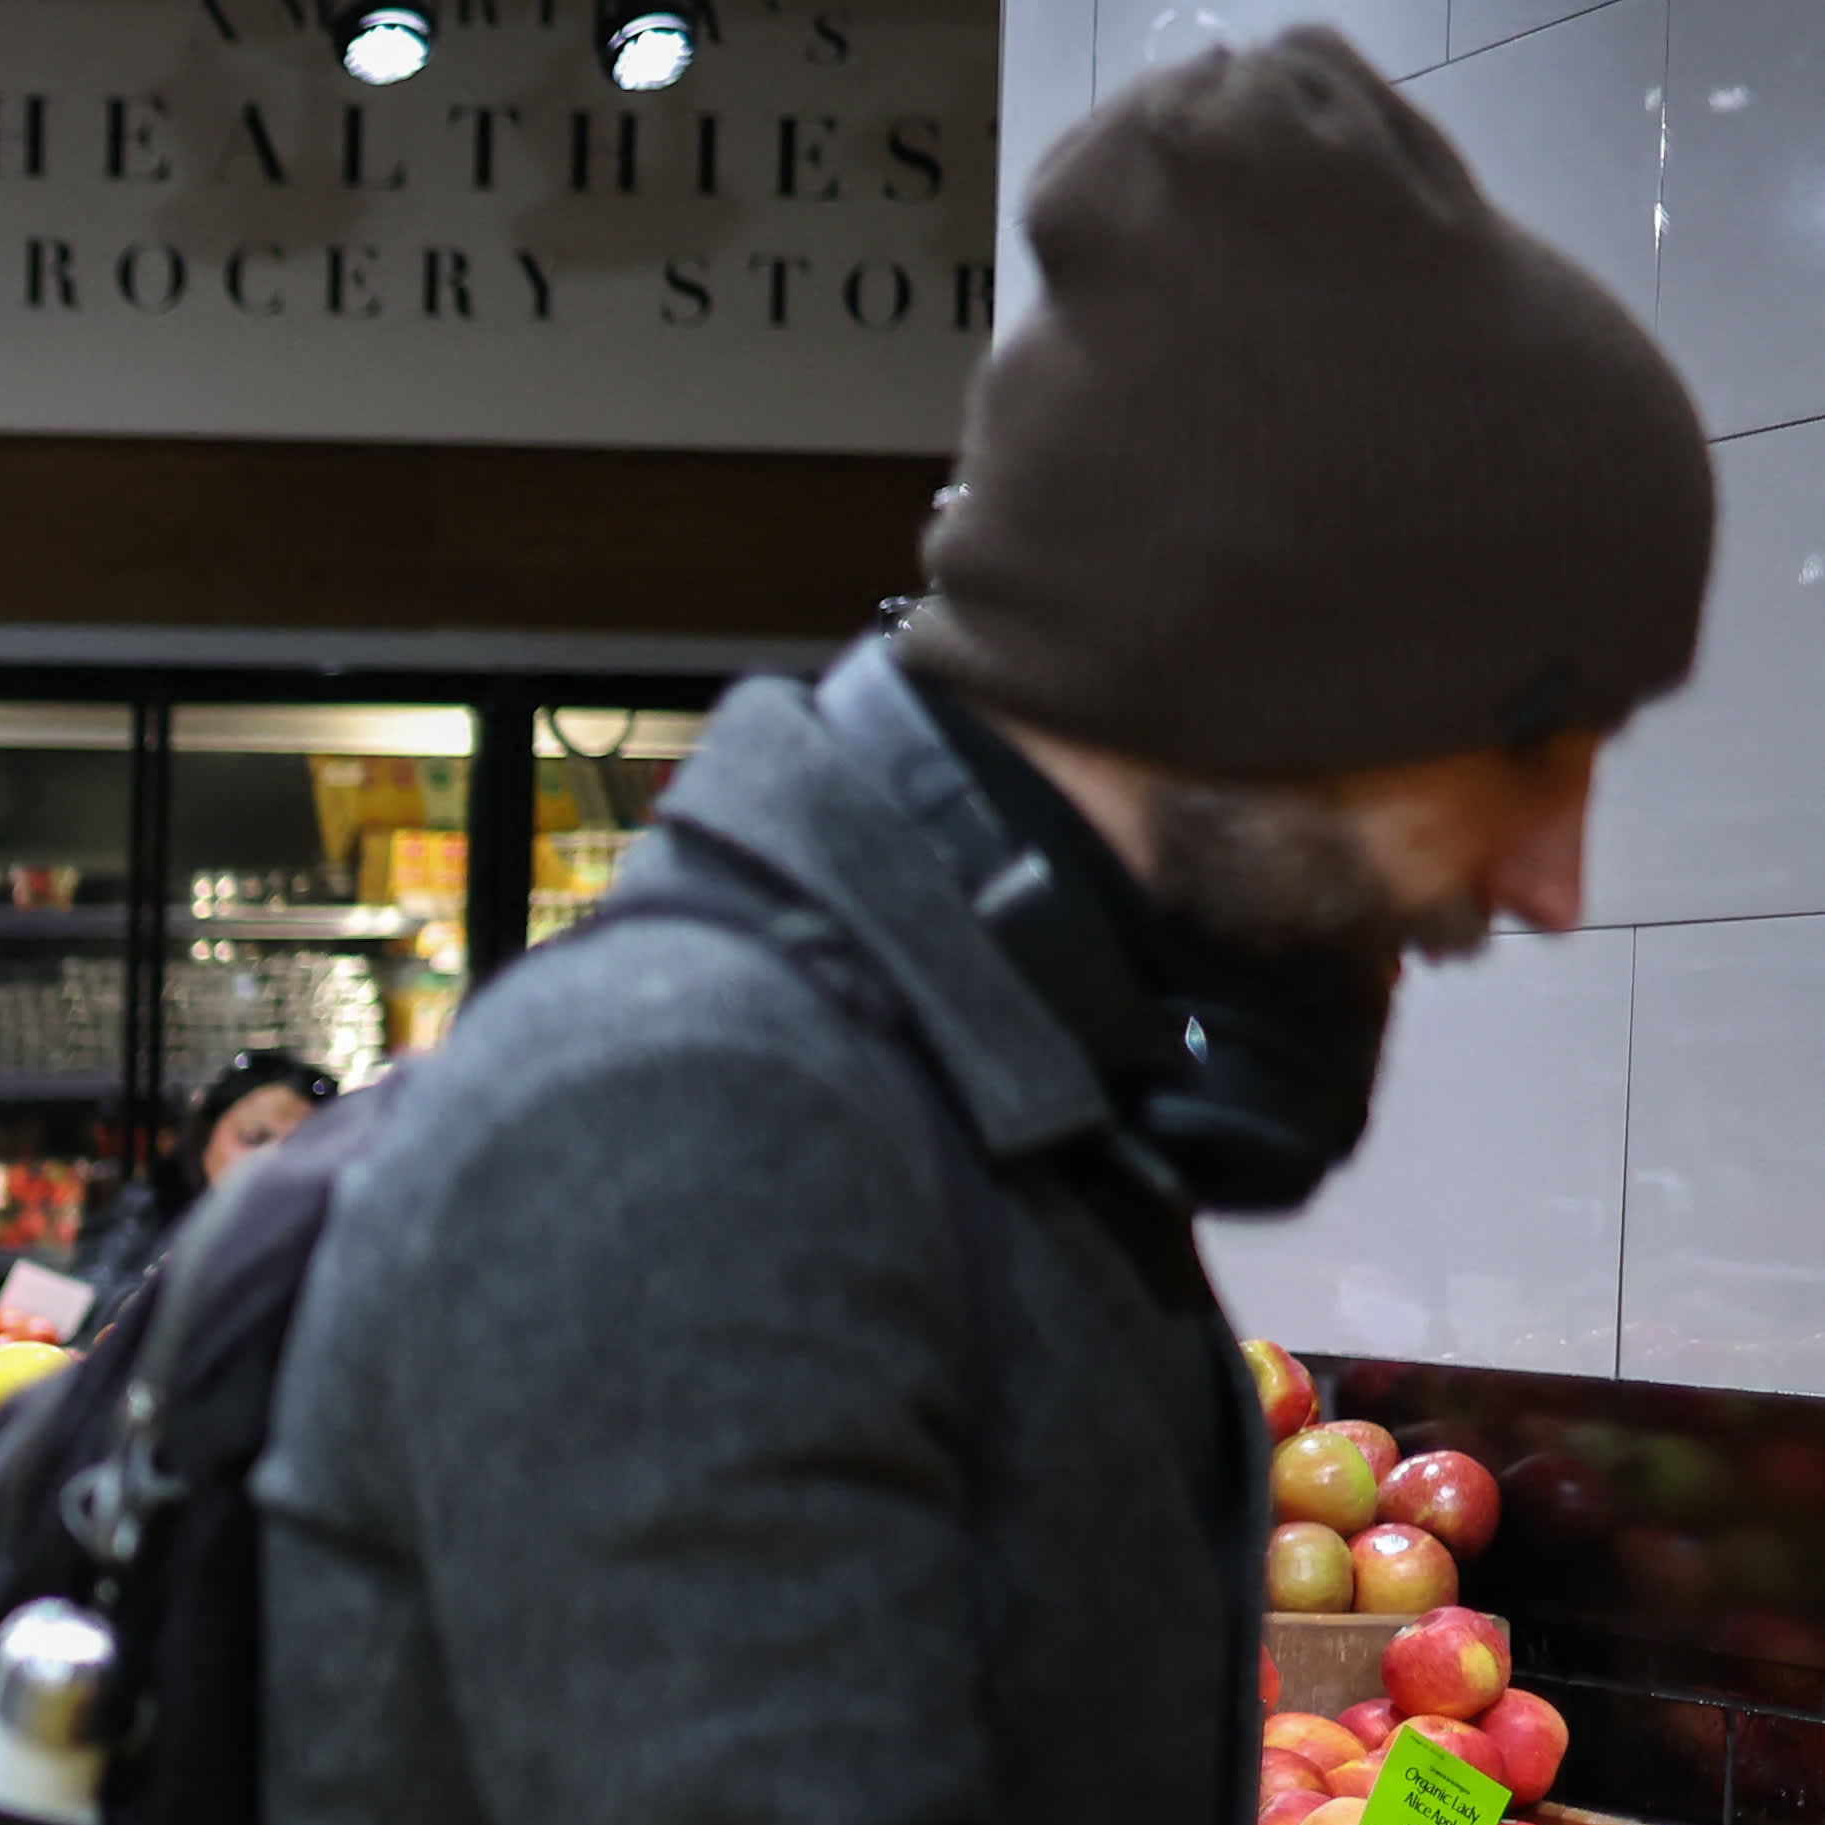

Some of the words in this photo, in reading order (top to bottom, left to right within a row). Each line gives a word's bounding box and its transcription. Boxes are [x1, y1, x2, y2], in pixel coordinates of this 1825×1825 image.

[1404, 1791, 1432, 1818] Alice
[1405, 1767, 1451, 1805] Organic
[1451, 1795, 1480, 1825] Lady
